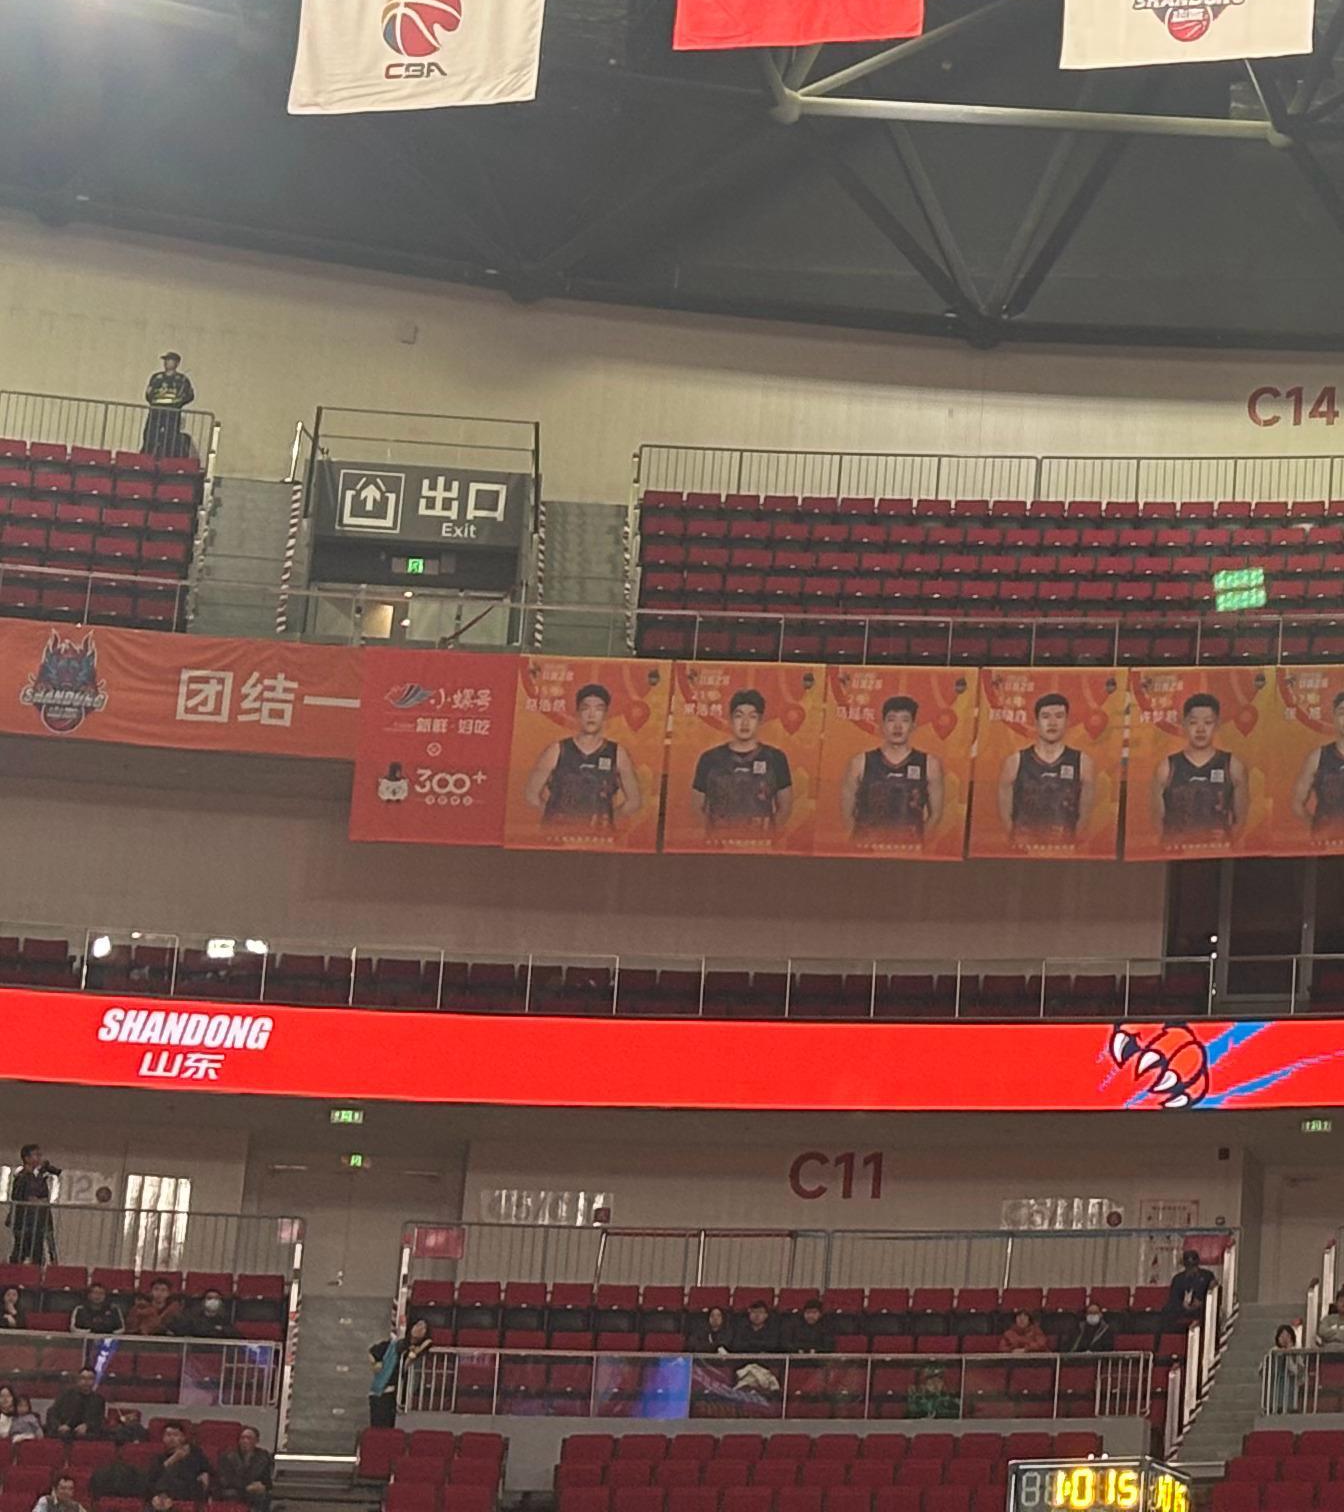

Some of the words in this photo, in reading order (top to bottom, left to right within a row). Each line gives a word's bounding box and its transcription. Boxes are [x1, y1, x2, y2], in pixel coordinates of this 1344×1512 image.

[384, 62, 447, 80] CBA
[1247, 386, 1339, 427] C14
[418, 474, 508, 523] 出口
[441, 522, 477, 539] Exit
[176, 669, 361, 728] 团结一
[98, 1008, 273, 1050] SHANDONG
[138, 1051, 225, 1080] 山东
[789, 1151, 884, 1200] C11
